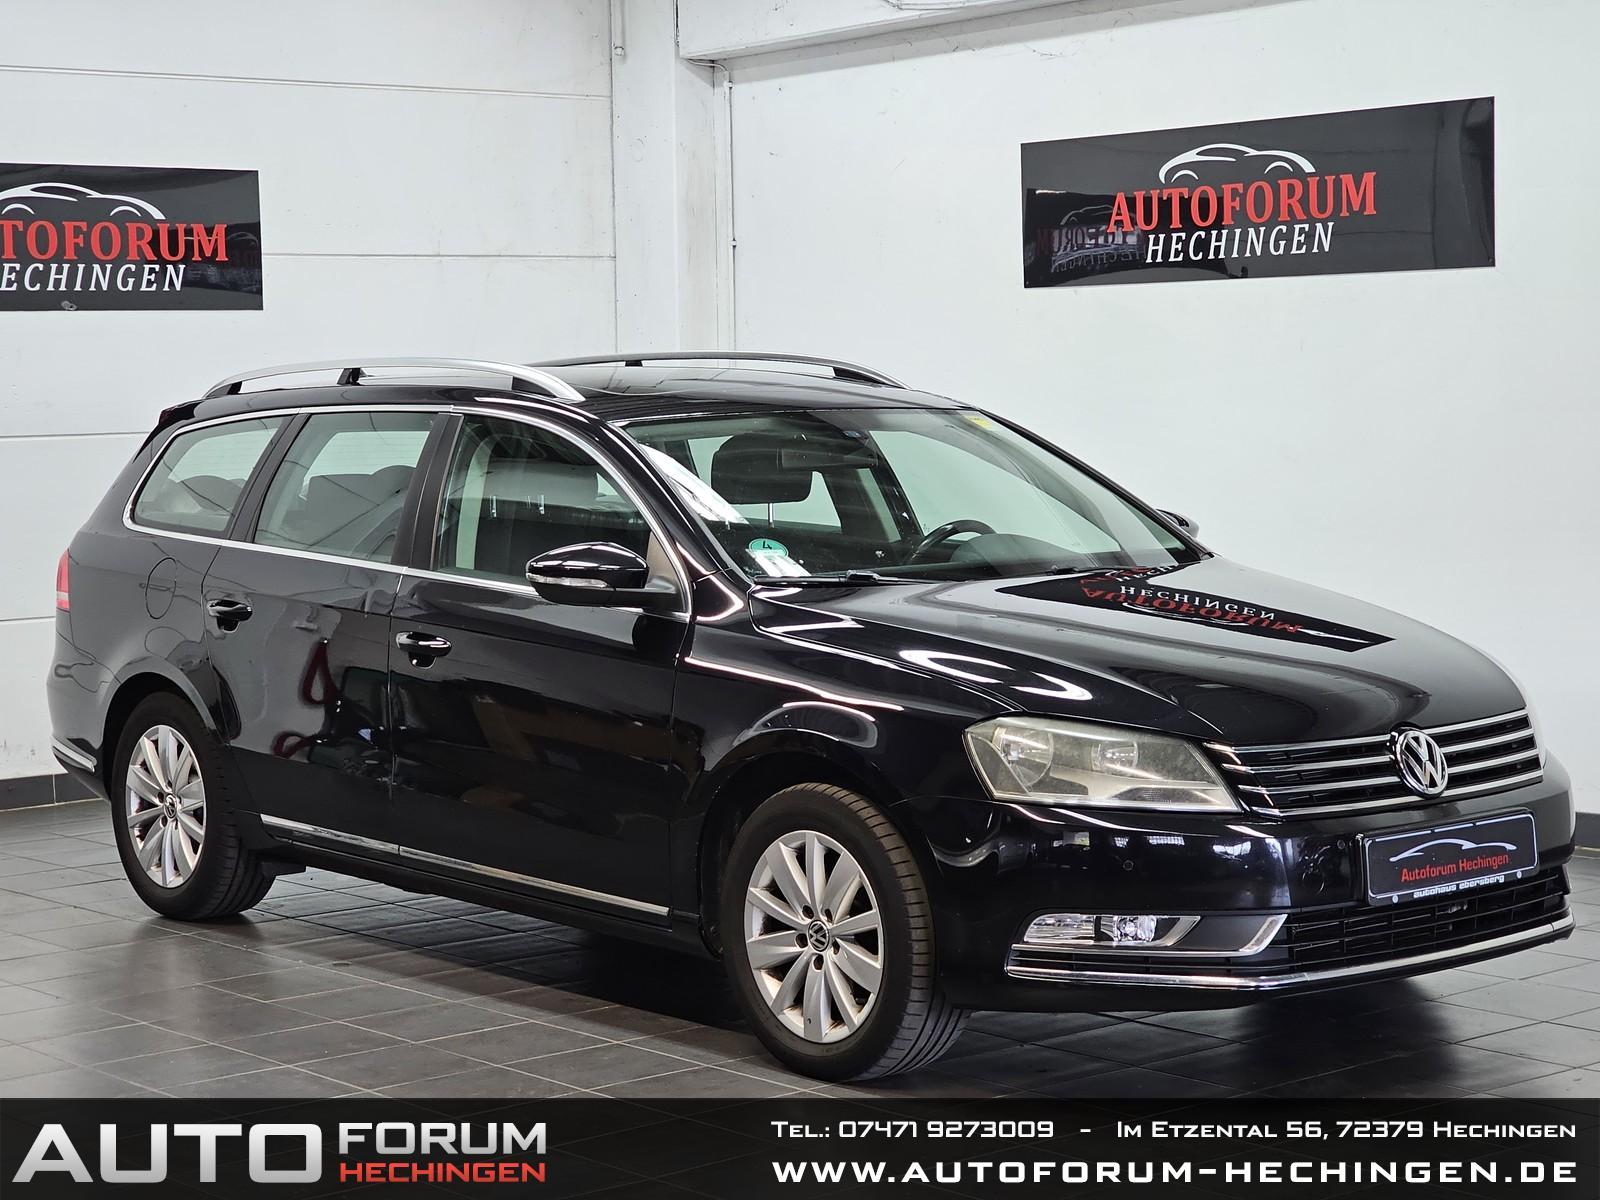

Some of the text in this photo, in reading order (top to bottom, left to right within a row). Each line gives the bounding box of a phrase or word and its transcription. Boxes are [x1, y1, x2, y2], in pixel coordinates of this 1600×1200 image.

[1106, 171, 1377, 234] AUTOFORUM
[1145, 221, 1335, 264] HECHINGEN
[1401, 855, 1509, 882] Autoforum Hechingen
[1413, 874, 1505, 899] autohaus ebersberg
